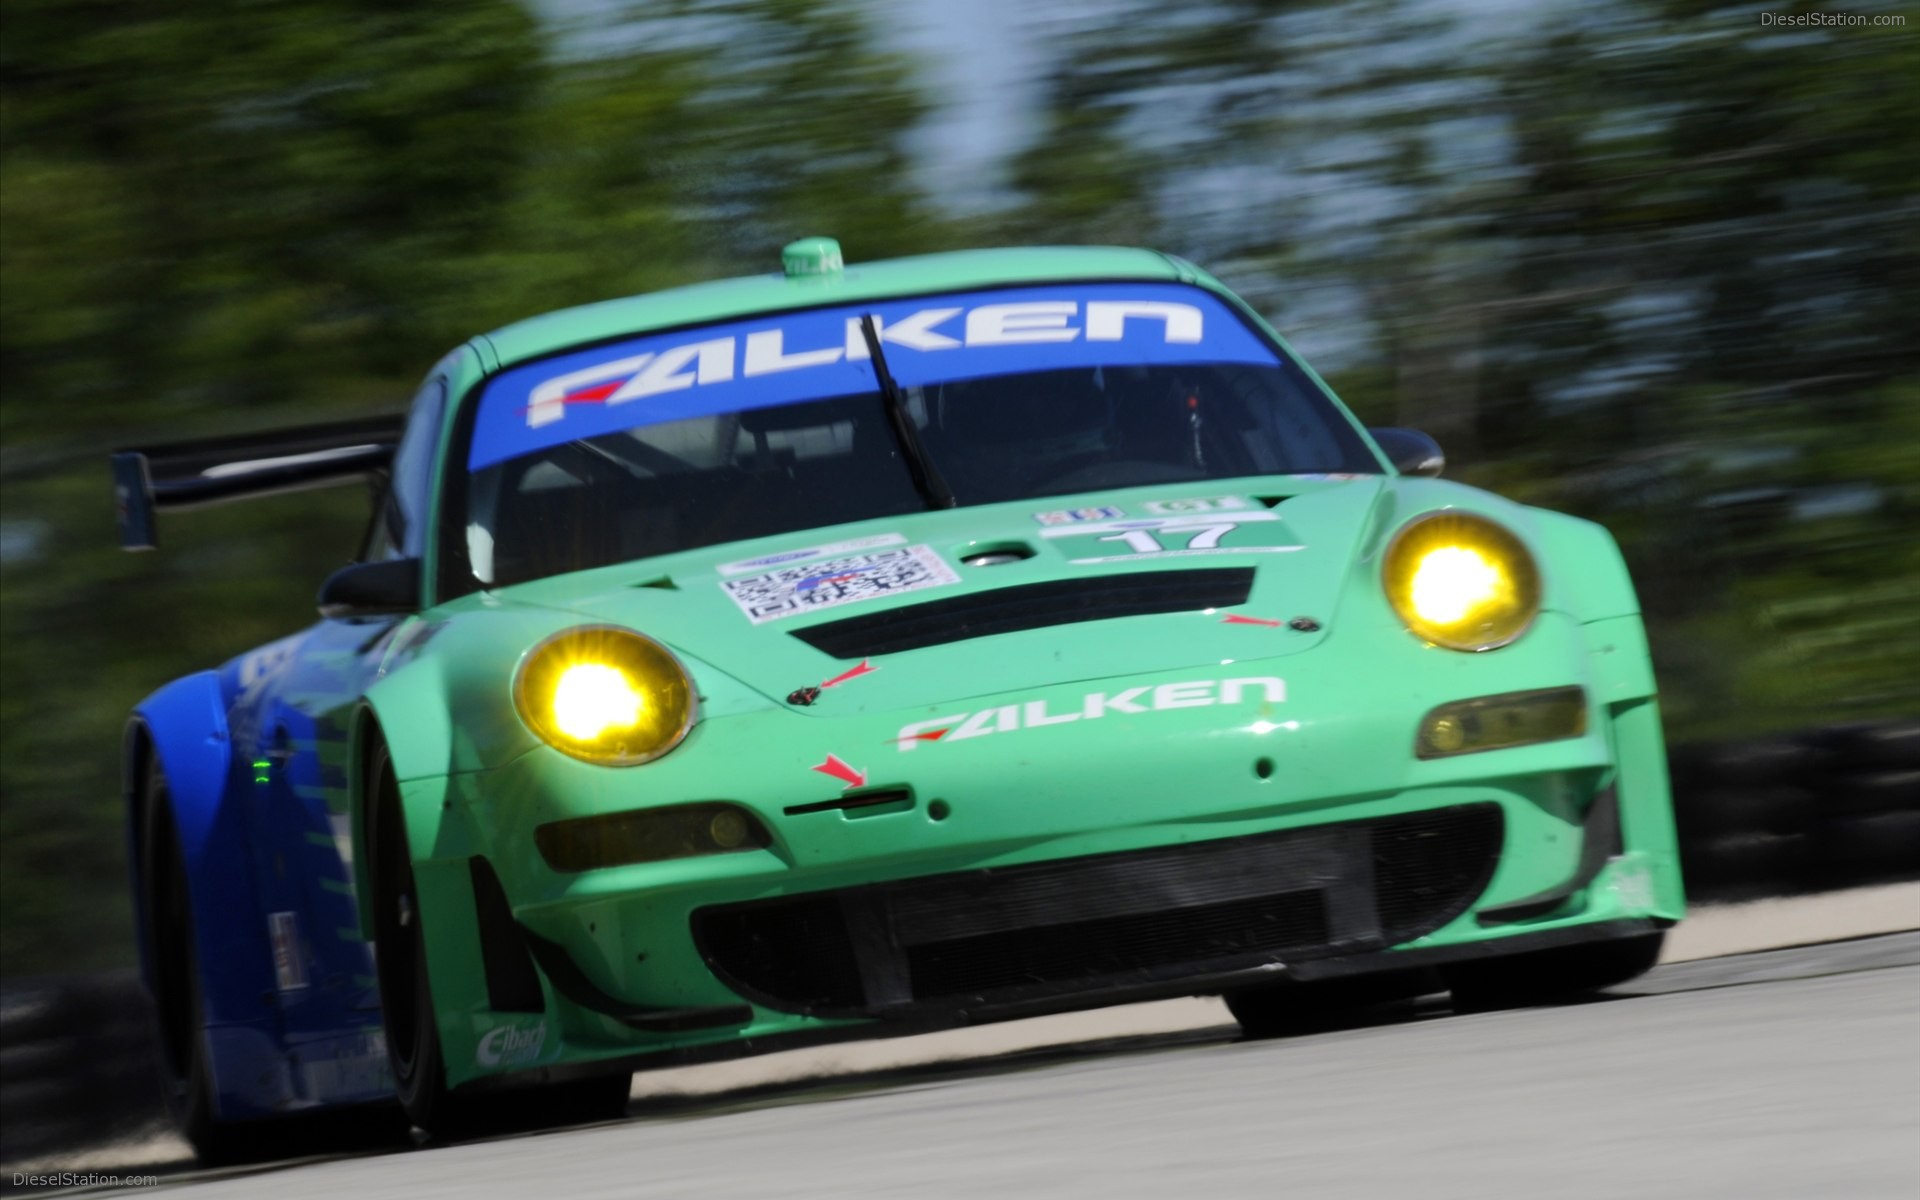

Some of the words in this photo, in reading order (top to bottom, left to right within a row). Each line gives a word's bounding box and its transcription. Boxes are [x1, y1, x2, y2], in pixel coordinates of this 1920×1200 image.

[525, 301, 1203, 429] FALKEN
[1096, 522, 1239, 554] 17
[894, 676, 1287, 753] FALKEN
